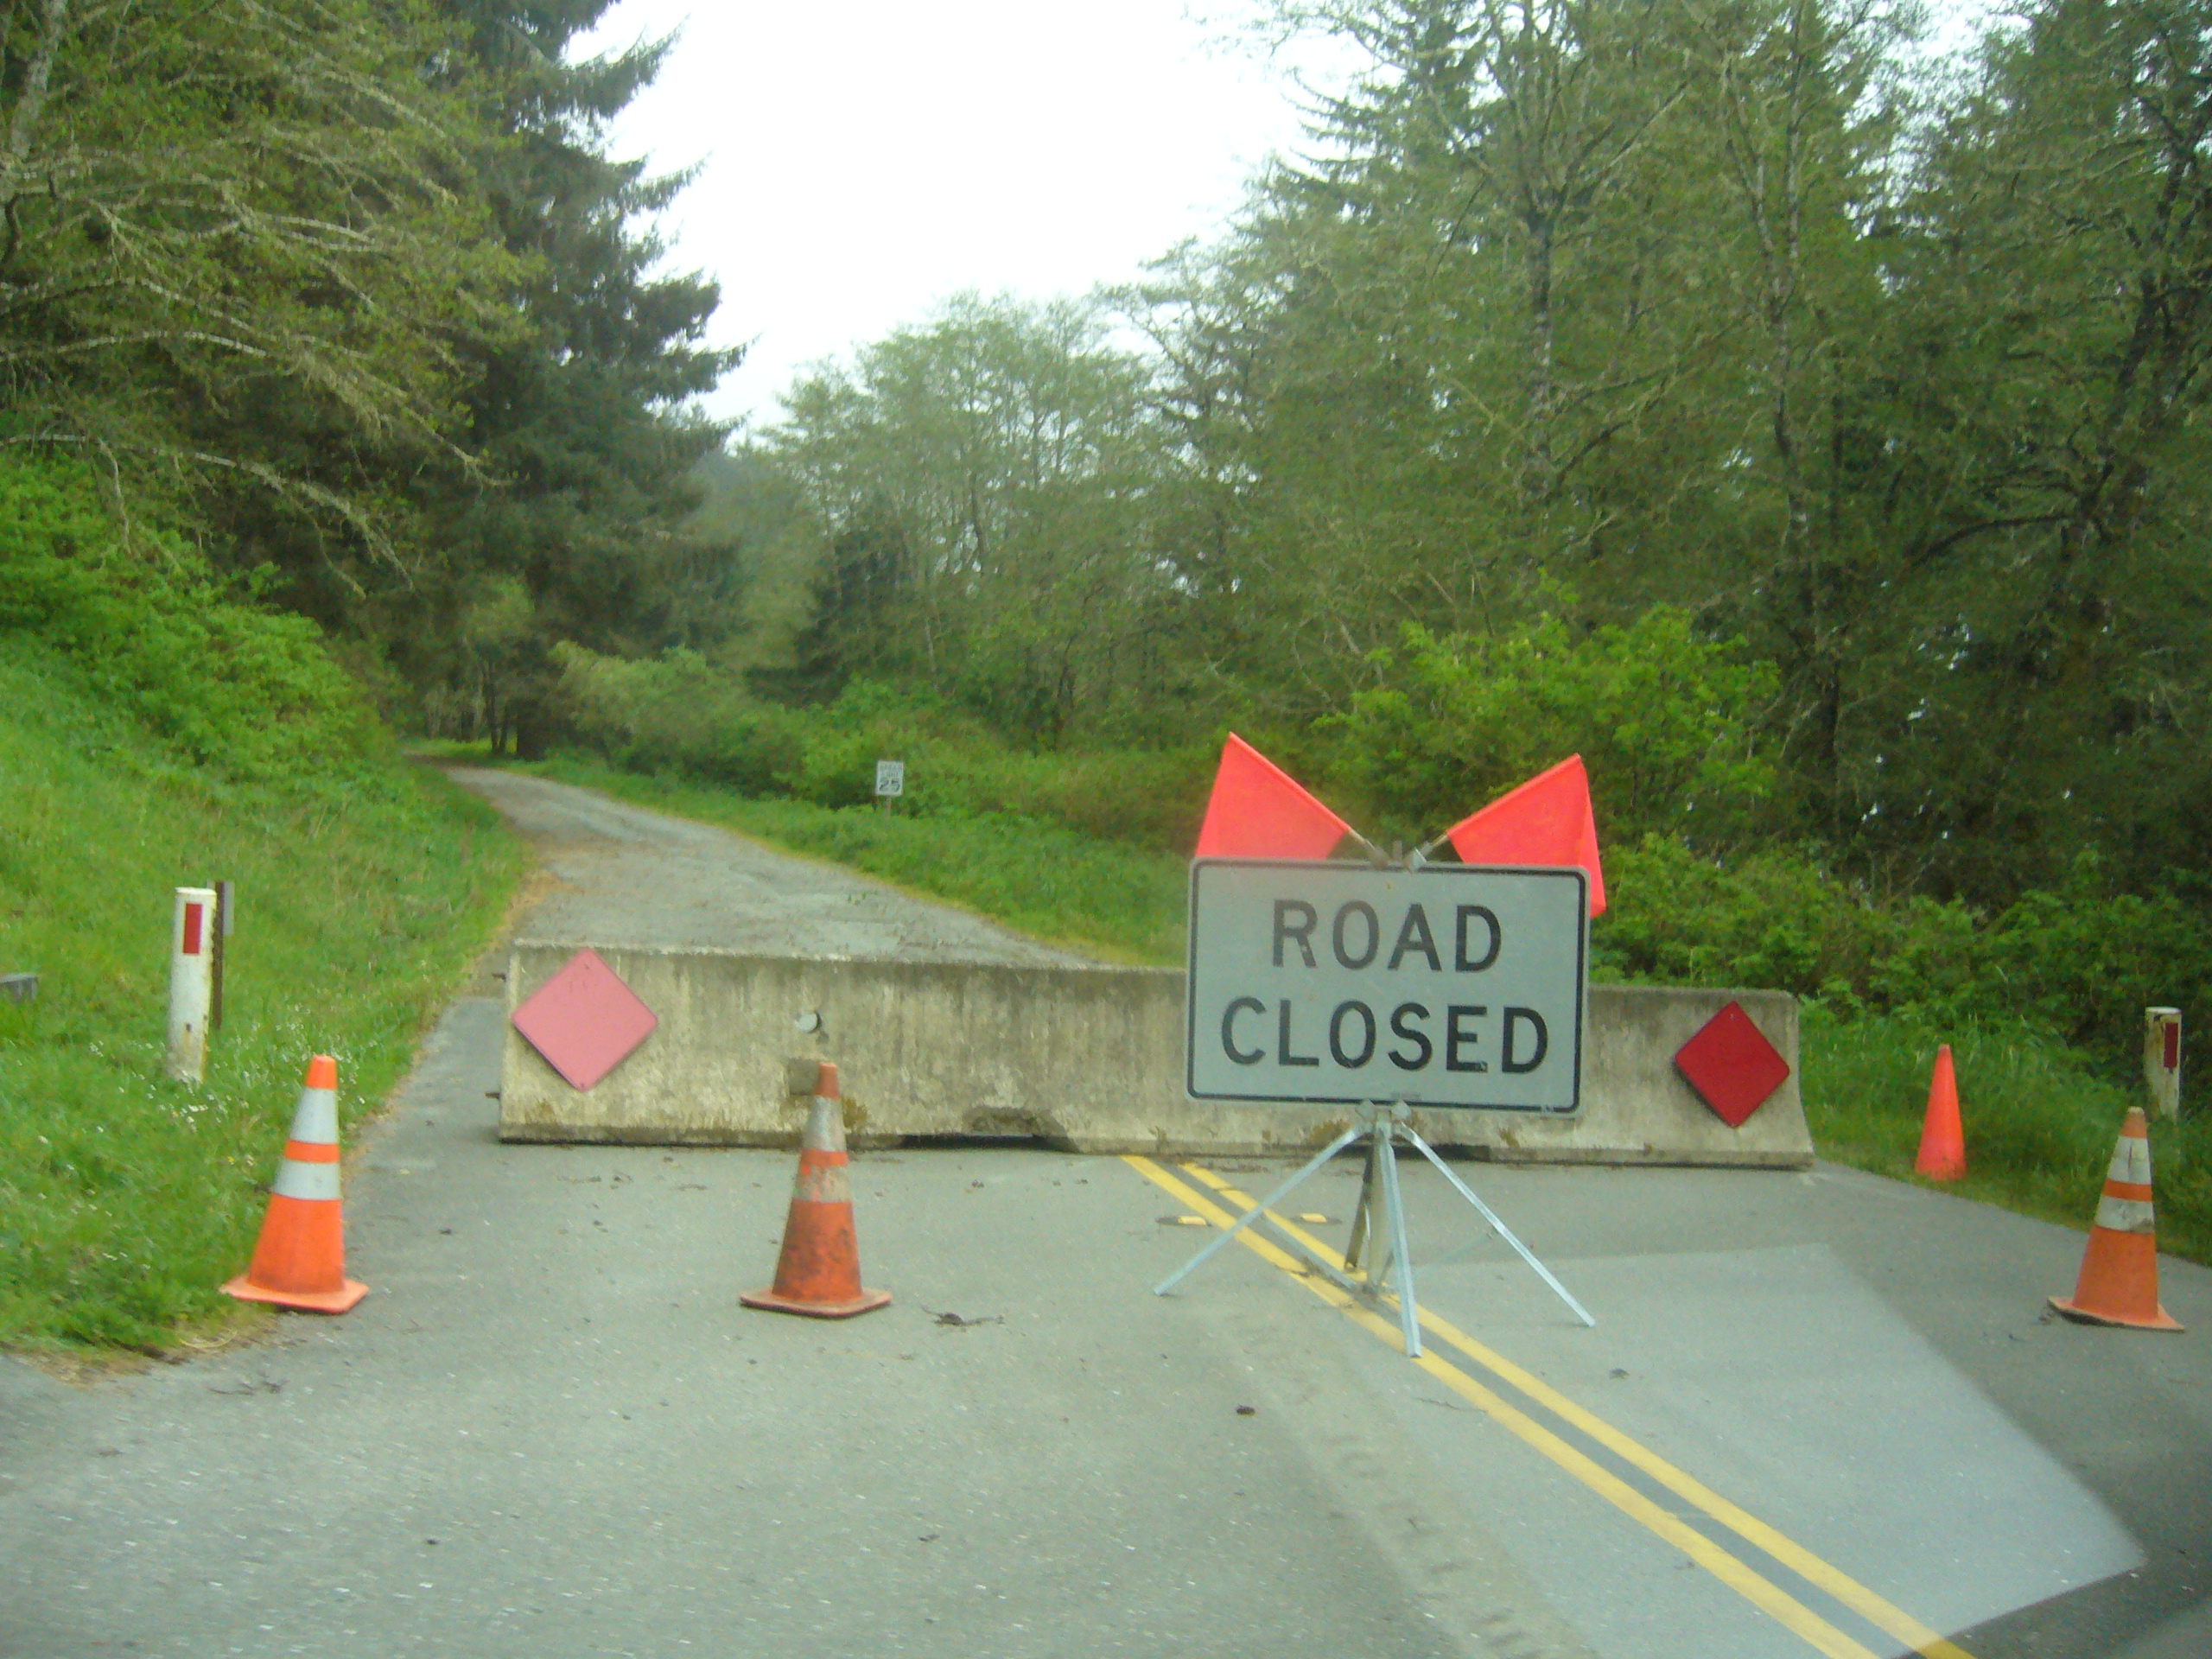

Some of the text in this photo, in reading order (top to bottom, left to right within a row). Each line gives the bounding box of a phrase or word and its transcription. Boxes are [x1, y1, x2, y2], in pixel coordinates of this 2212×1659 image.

[879, 778, 900, 792] 25
[1273, 899, 1502, 973] ROAD
[1221, 996, 1549, 1074] CLOSED
